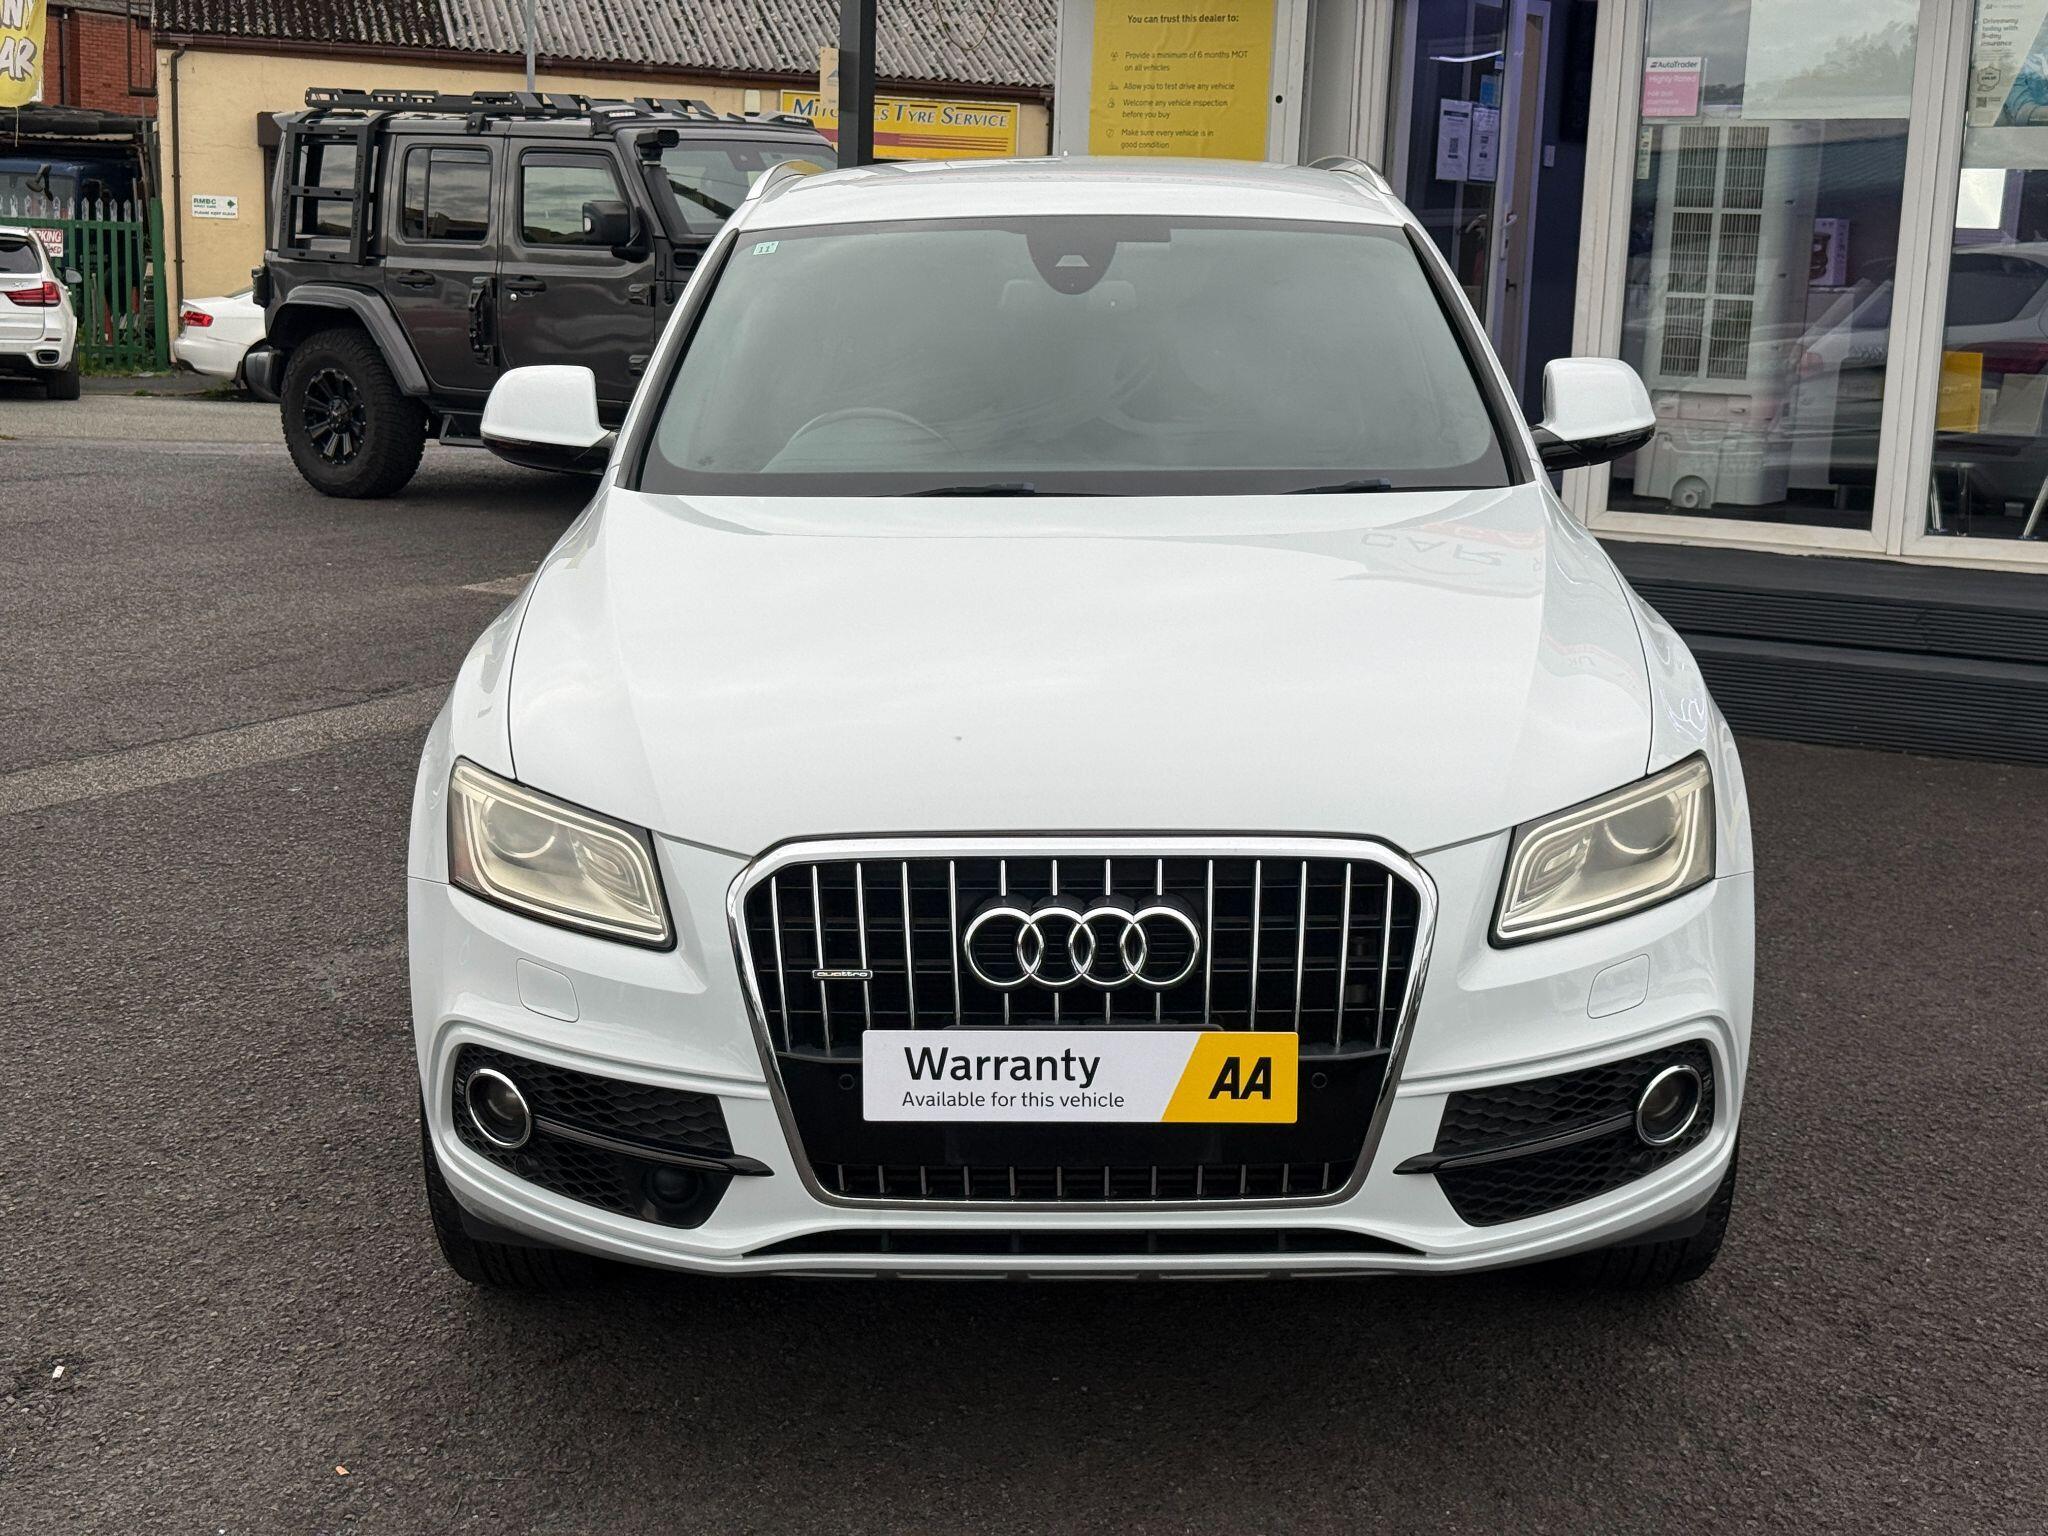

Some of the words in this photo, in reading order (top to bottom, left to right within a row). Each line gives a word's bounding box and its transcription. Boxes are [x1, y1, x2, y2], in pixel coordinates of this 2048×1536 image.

[1128, 14, 1142, 24] You
[1144, 15, 1159, 24] can
[1160, 14, 1180, 23] trust
[1182, 14, 1197, 23] this
[1199, 13, 1225, 23] dealer
[1227, 14, 1239, 23] to:
[1125, 51, 1150, 59] Provide
[1157, 51, 1187, 59] minimum
[1189, 51, 1197, 59] of
[1204, 51, 1230, 59] months
[1231, 51, 1248, 59] MOT
[1143, 64, 1170, 72] vehicles
[1657, 61, 1698, 69] AutoTrader
[1123, 82, 1142, 90] Allow
[1178, 82, 1196, 90] drive
[1210, 82, 1235, 90] vehicle
[1123, 99, 1152, 107] Welcome
[1167, 99, 1192, 107] vehicle
[1193, 99, 1228, 108] inspection
[894, 104, 935, 123] TYRE
[941, 106, 1008, 127] SERVICE
[1158, 111, 1170, 119] buy
[1155, 130, 1174, 138] every
[1174, 129, 1200, 137] vehicle
[1121, 141, 1138, 149] good
[1138, 141, 1170, 149] condition
[903, 1046, 1101, 1089] Warranty
[1208, 1056, 1272, 1100] AA
[902, 1091, 986, 1107] Available
[991, 1091, 1017, 1107] for
[1021, 1091, 1055, 1107] this
[1059, 1092, 1125, 1108] vehicle
